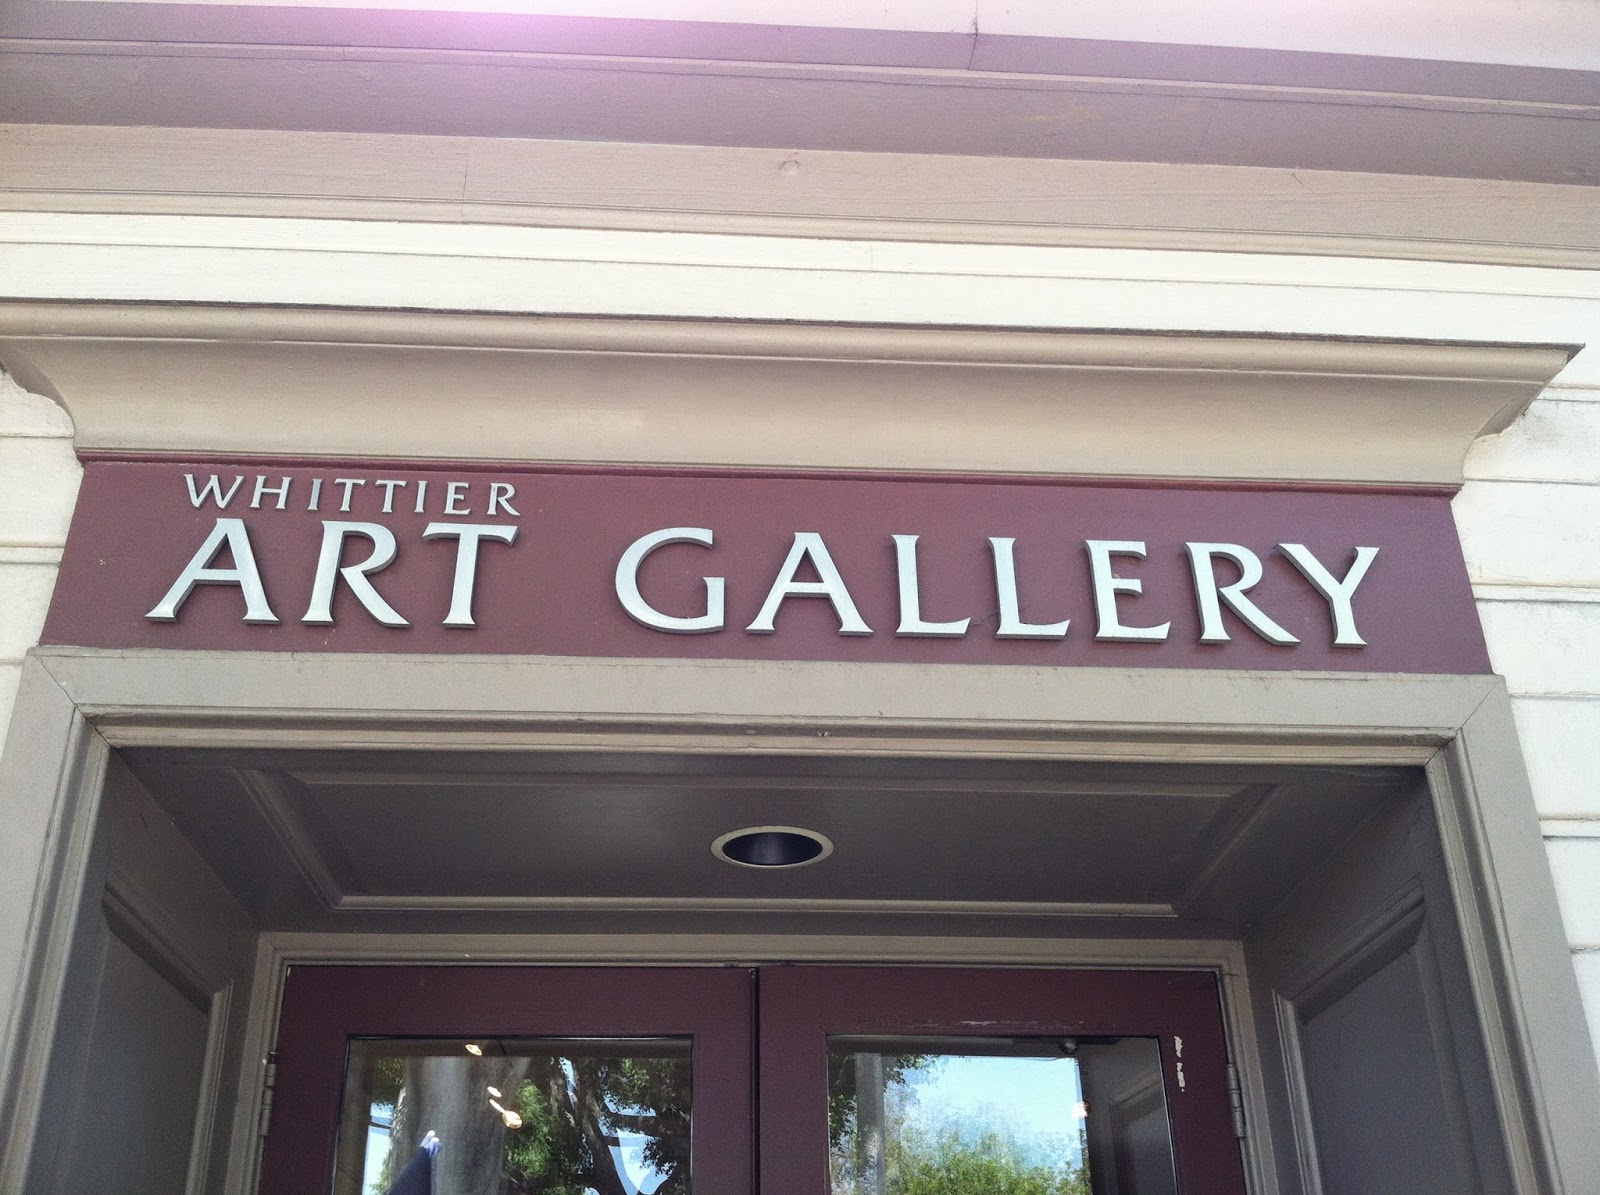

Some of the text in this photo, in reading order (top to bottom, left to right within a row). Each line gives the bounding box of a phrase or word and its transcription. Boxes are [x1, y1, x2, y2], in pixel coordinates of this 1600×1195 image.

[183, 473, 521, 516] WHITTIER
[144, 517, 1381, 648] ART GALLERY
